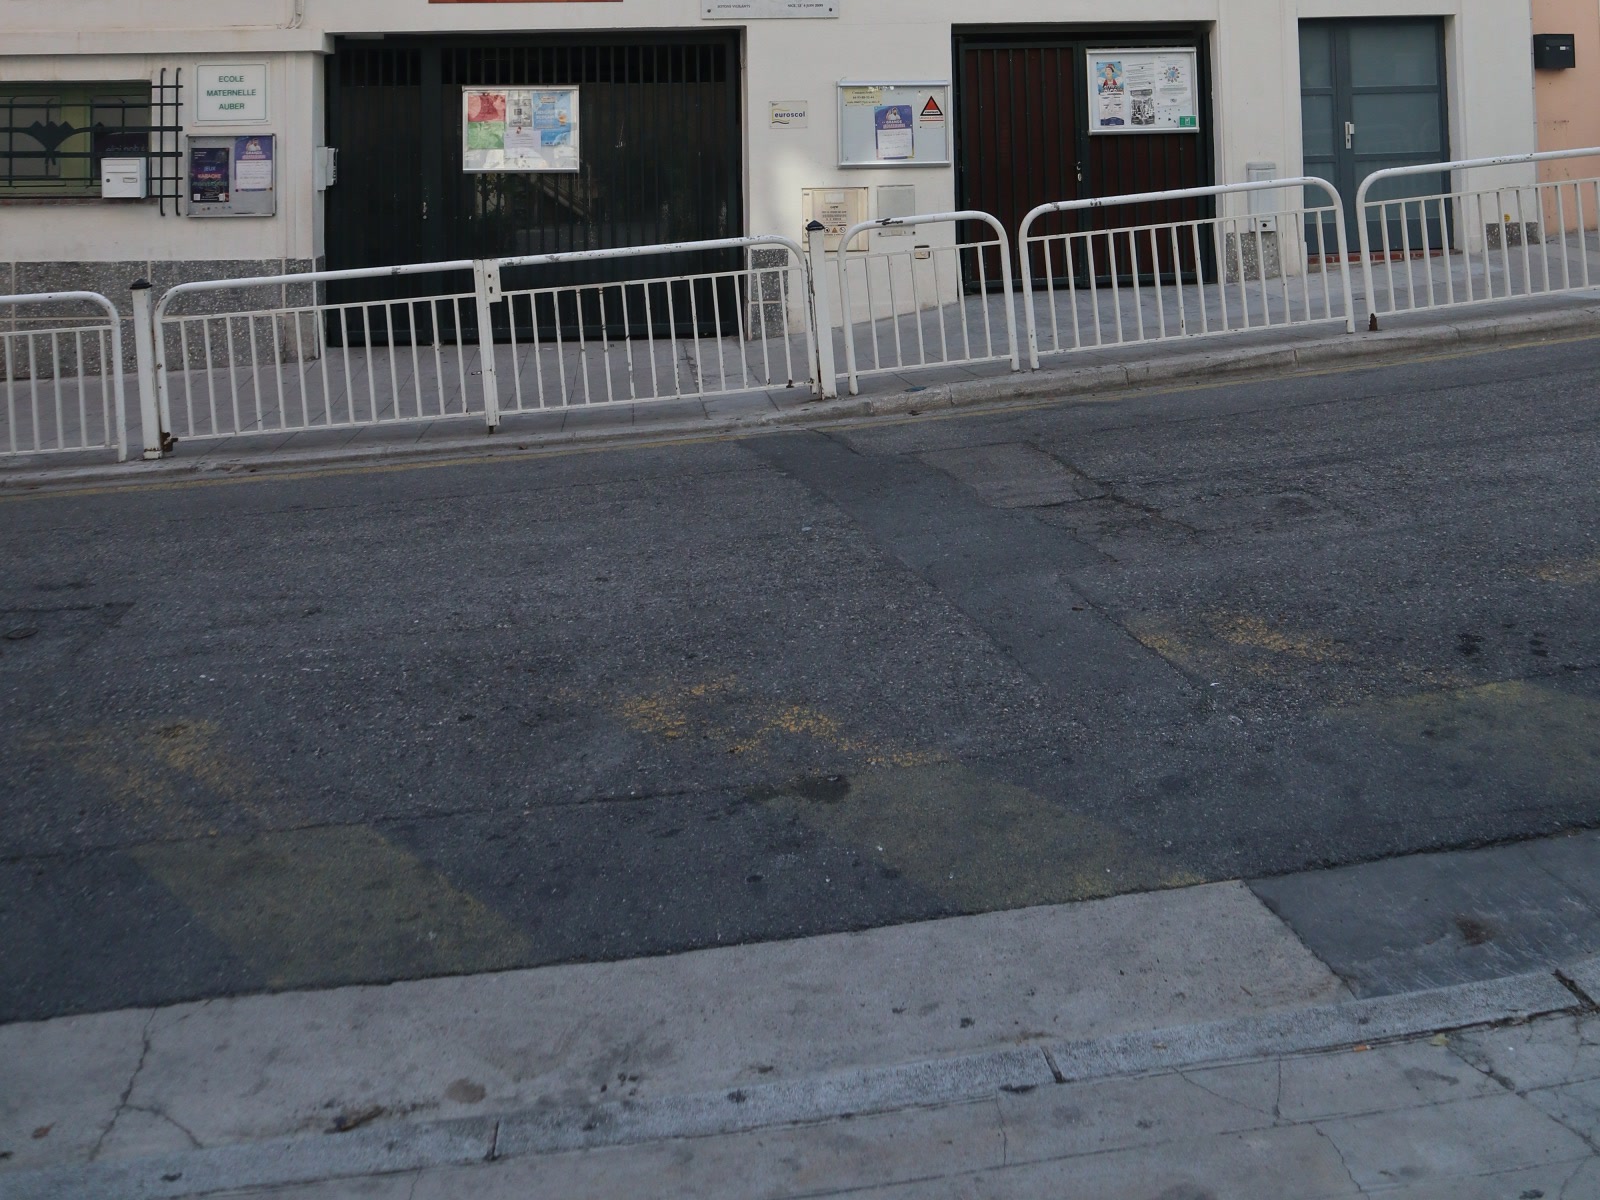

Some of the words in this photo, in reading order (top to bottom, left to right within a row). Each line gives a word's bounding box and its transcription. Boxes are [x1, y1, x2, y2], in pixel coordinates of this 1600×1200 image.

[218, 75, 245, 83] ECOLE
[206, 89, 257, 97] MATERNELLE
[218, 102, 245, 110] AUBER
